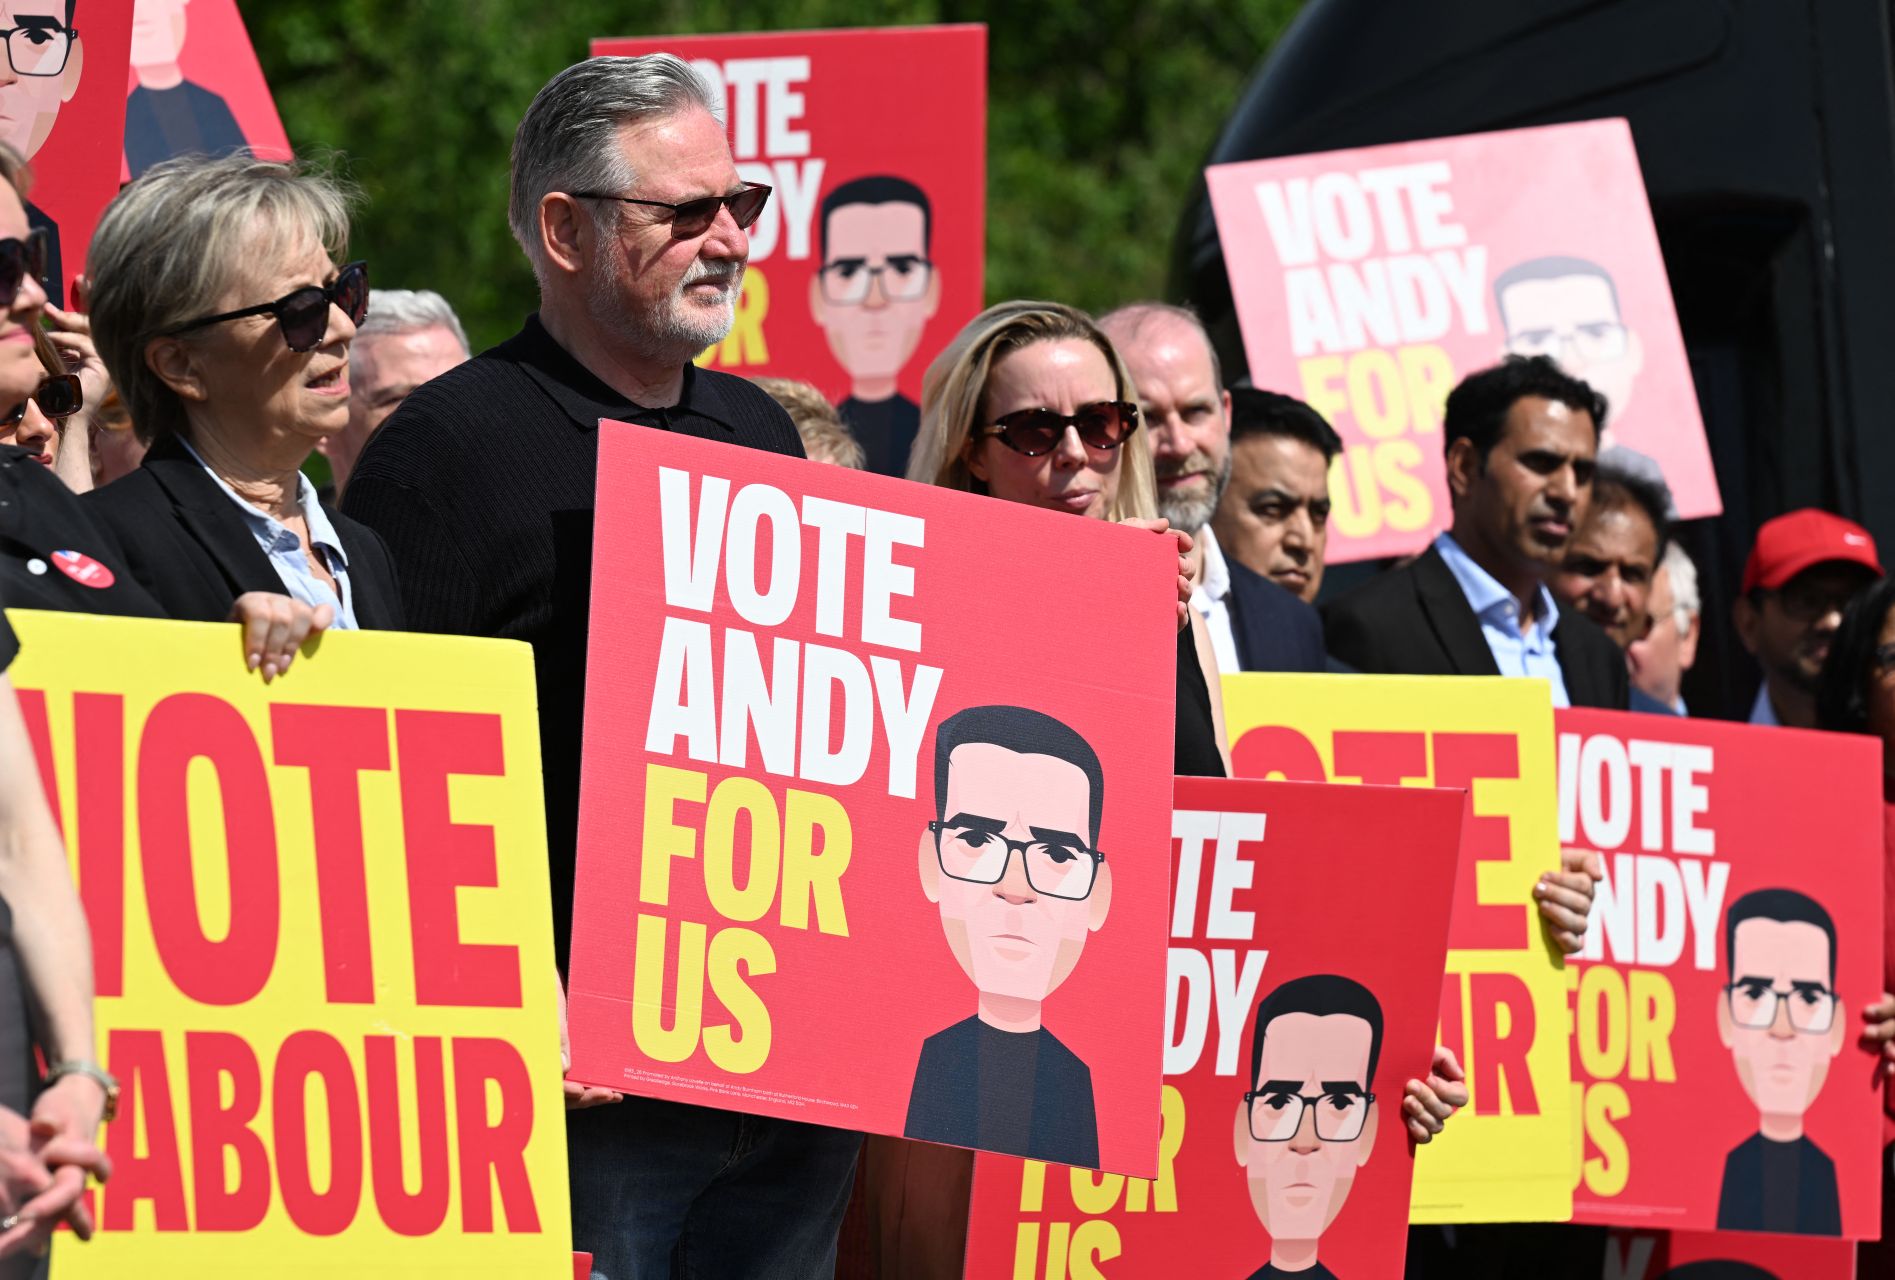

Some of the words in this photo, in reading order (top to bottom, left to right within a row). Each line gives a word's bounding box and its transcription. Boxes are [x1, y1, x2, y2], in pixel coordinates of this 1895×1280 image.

[699, 55, 810, 158] TE
[1254, 161, 1467, 267] VOTE
[1283, 246, 1489, 357] ANDY
[1298, 345, 1456, 440] FOR
[1326, 440, 1435, 539] US
[658, 465, 925, 653] VOTE
[644, 615, 944, 800] ANDY
[638, 763, 853, 938] FOR
[1171, 810, 1267, 940] TE
[1582, 852, 1731, 971] NDY
[632, 913, 777, 1074] US
[1163, 947, 1270, 1076] DY
[57, 1028, 542, 1236] ABOUR
